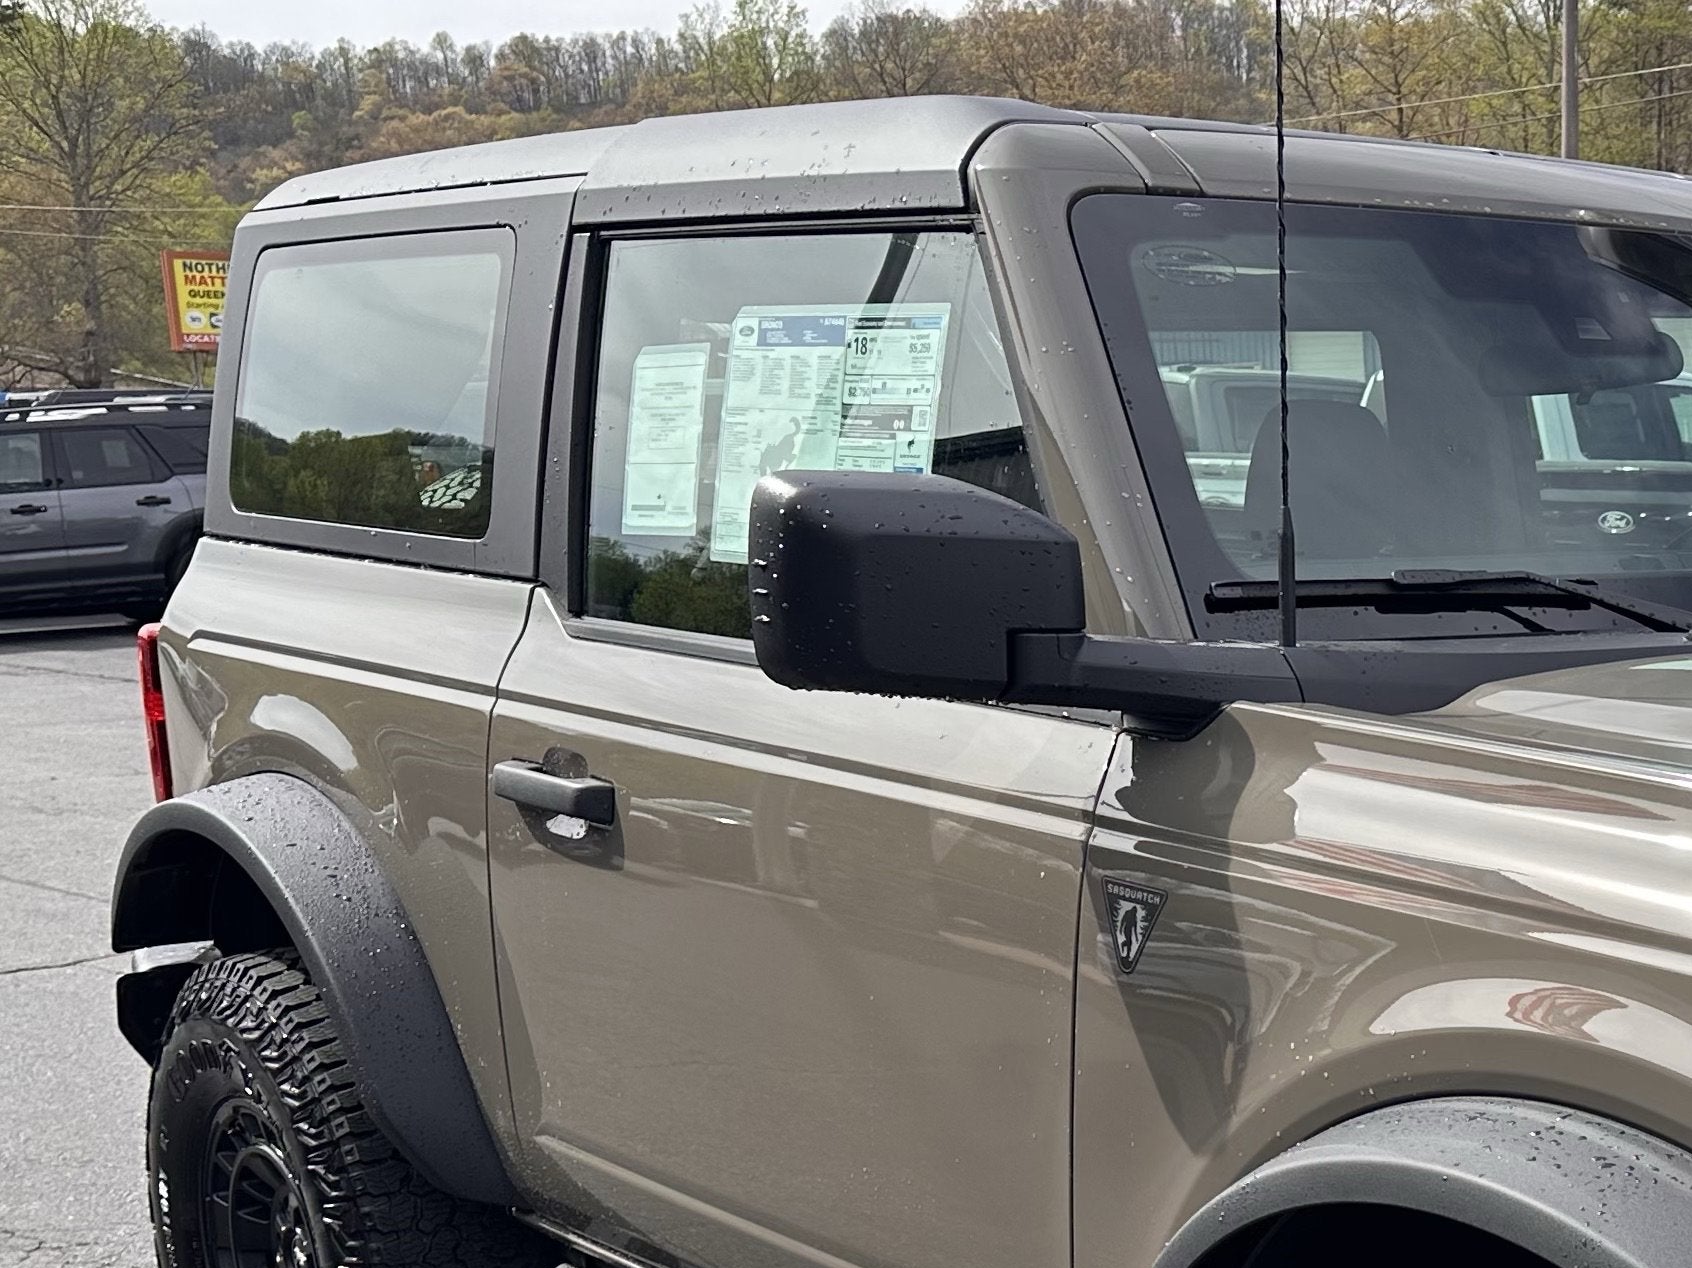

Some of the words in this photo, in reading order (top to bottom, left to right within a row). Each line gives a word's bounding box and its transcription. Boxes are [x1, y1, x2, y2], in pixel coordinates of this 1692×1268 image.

[184, 275, 227, 287] MATT
[184, 334, 218, 342] LOCAT
[1107, 883, 1161, 905] SASQUATCH
